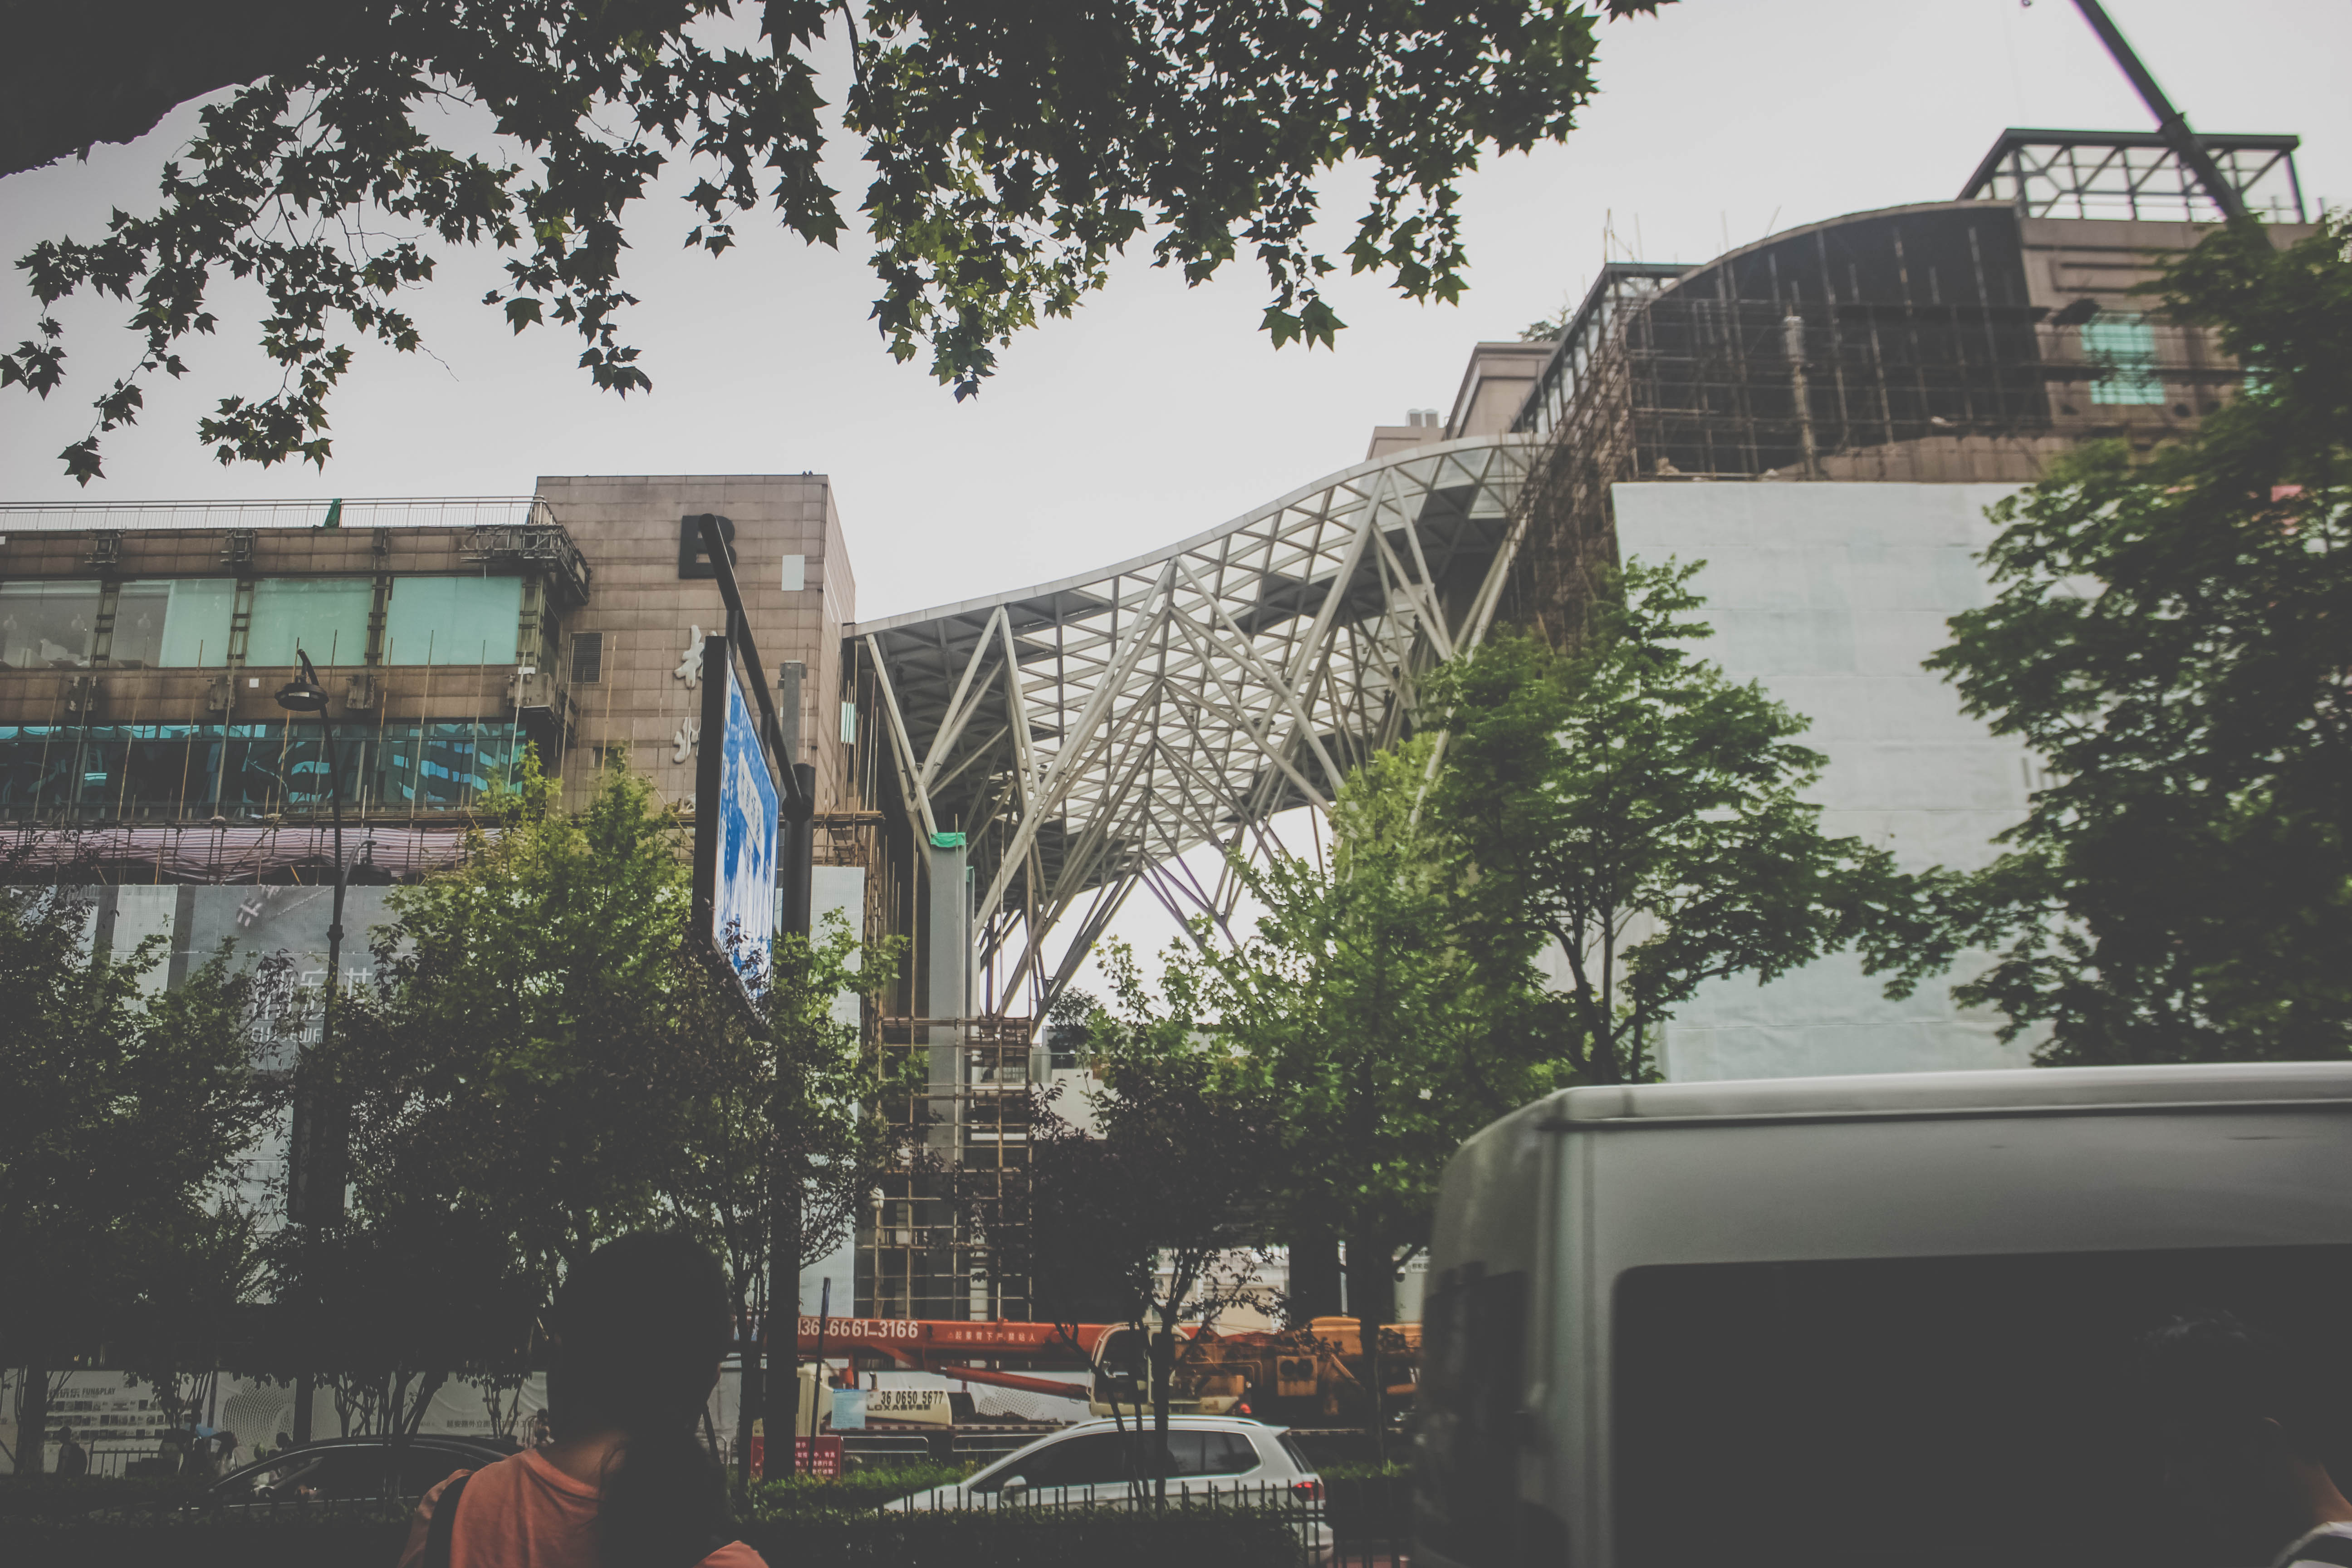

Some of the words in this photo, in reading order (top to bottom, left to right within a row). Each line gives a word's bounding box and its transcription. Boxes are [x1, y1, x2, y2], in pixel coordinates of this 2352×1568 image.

[881, 1391, 891, 1405] 36
[896, 1391, 917, 1405] 0650
[922, 1391, 943, 1405] 5677
